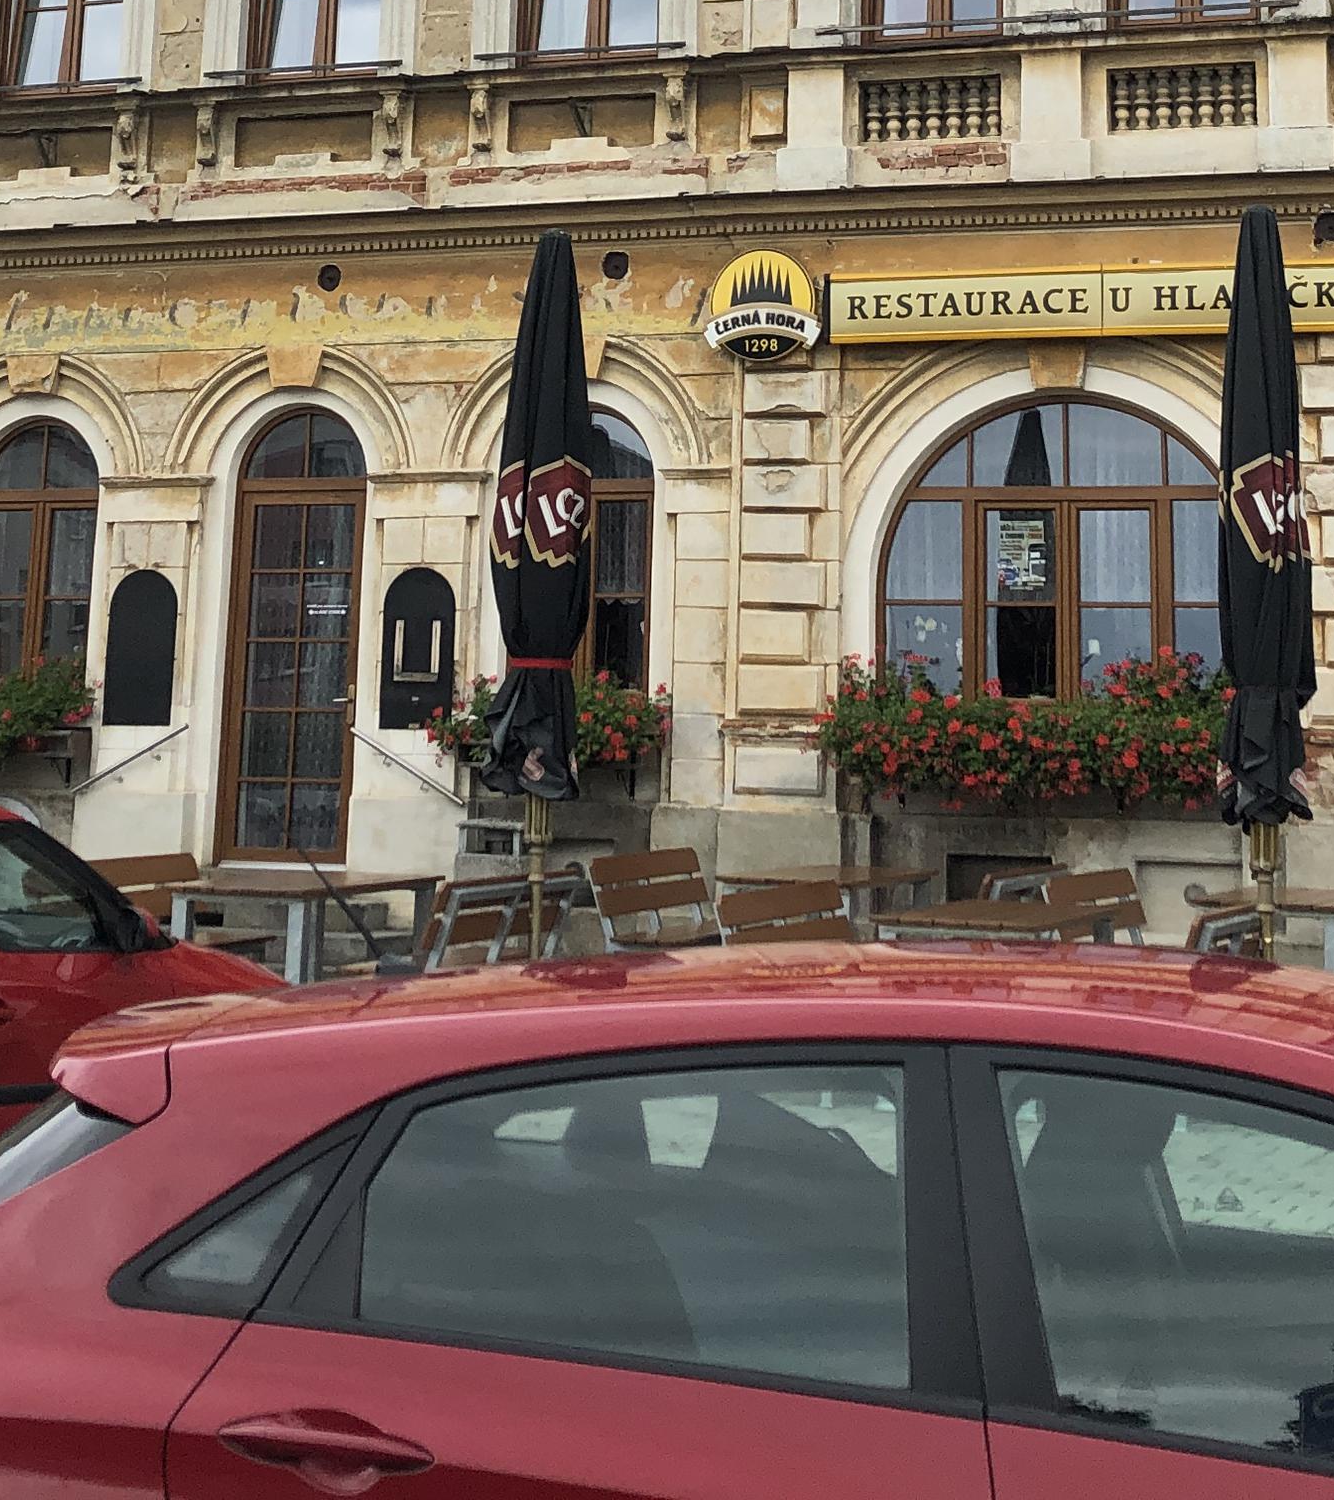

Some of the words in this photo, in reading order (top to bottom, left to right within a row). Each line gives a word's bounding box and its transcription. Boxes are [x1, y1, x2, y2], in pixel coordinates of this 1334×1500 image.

[847, 287, 1090, 320] RESTAURACE
[1109, 287, 1133, 313] U
[714, 309, 762, 335] ČERNÁ
[765, 312, 806, 333] HORA
[744, 338, 779, 353] 1298
